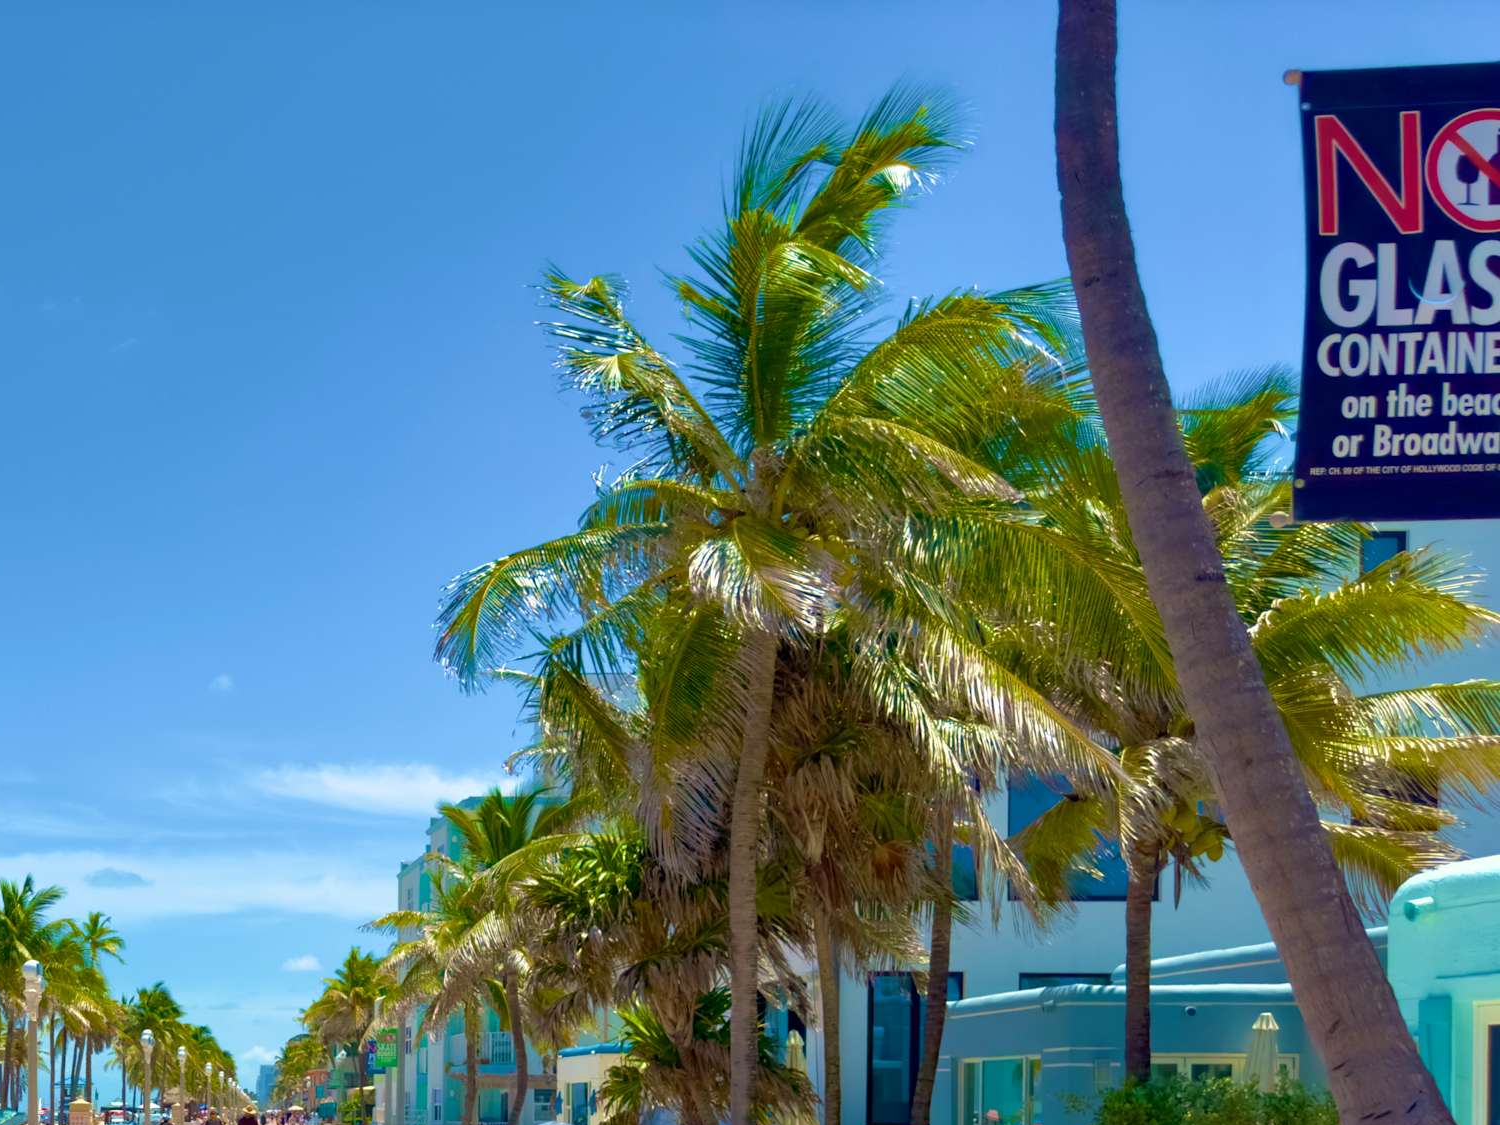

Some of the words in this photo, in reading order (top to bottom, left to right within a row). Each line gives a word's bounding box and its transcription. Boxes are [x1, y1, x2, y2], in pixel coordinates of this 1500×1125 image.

[1316, 332, 1500, 377] CONTAINE
[1341, 395, 1376, 419] on
[1386, 383, 1433, 418] the
[1332, 433, 1364, 458] or
[1373, 421, 1500, 457] Broadwa
[1353, 466, 1365, 475] OF
[1366, 465, 1381, 474] THE
[1382, 465, 1400, 474] CITY
[1400, 465, 1412, 473] OF
[1413, 464, 1461, 473] HOLLYWOOD
[1462, 463, 1484, 472] CODE
[1485, 463, 1497, 471] OF
